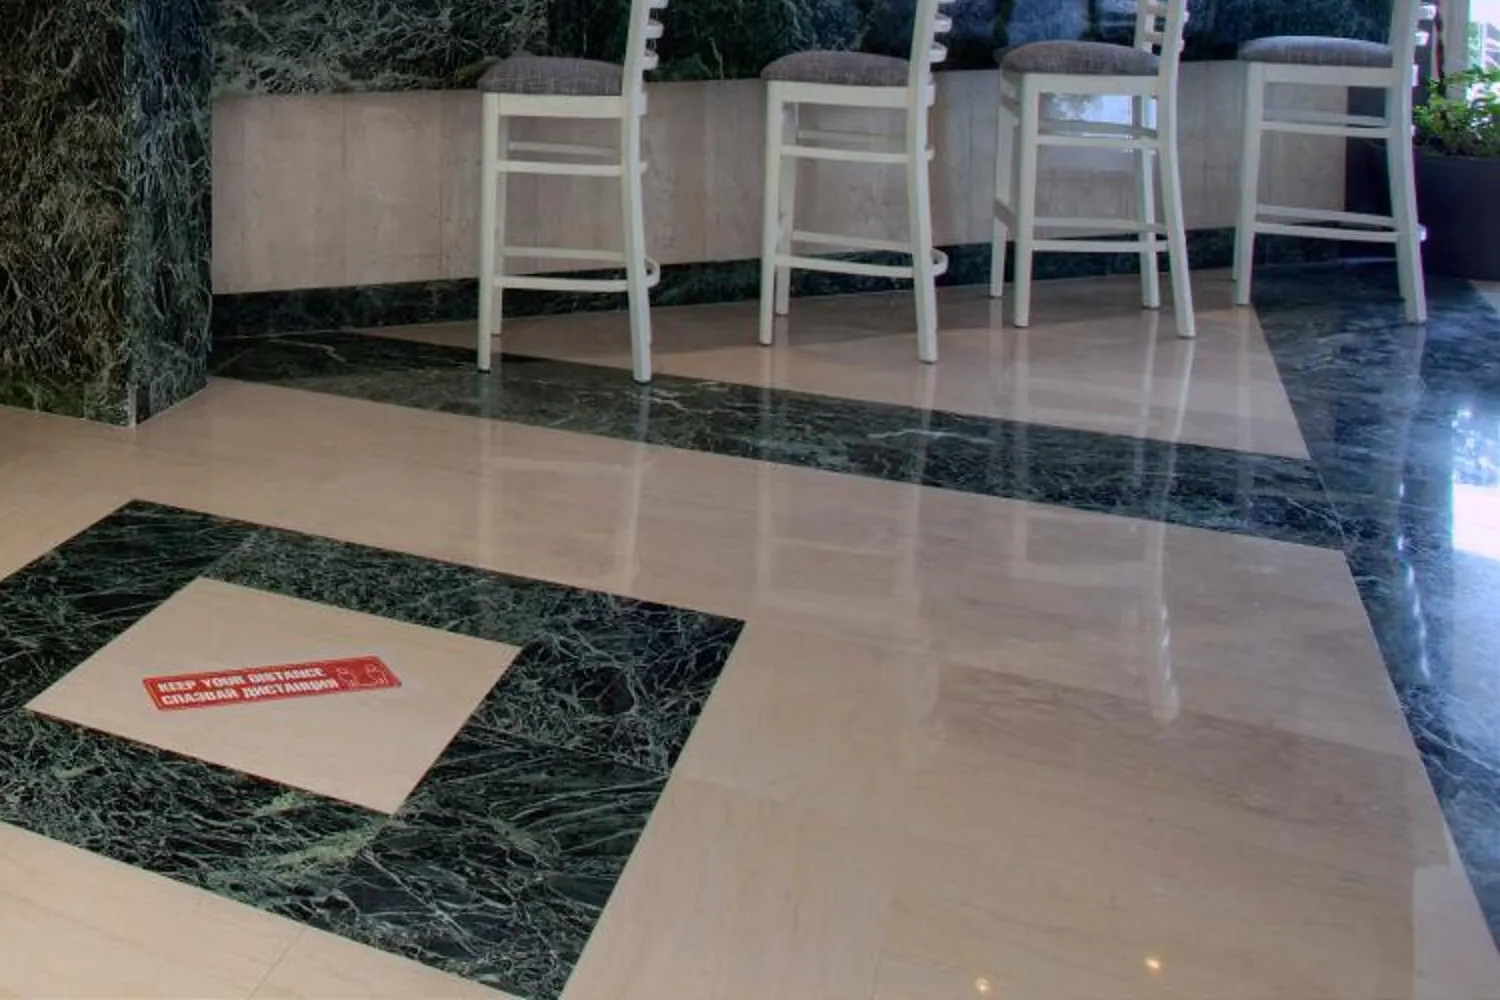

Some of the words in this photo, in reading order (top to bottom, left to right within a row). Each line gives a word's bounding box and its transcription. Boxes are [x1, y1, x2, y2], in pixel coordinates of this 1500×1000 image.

[157, 680, 196, 693] KEEP
[200, 675, 245, 688] YOUR
[247, 667, 326, 684] DISTANCE
